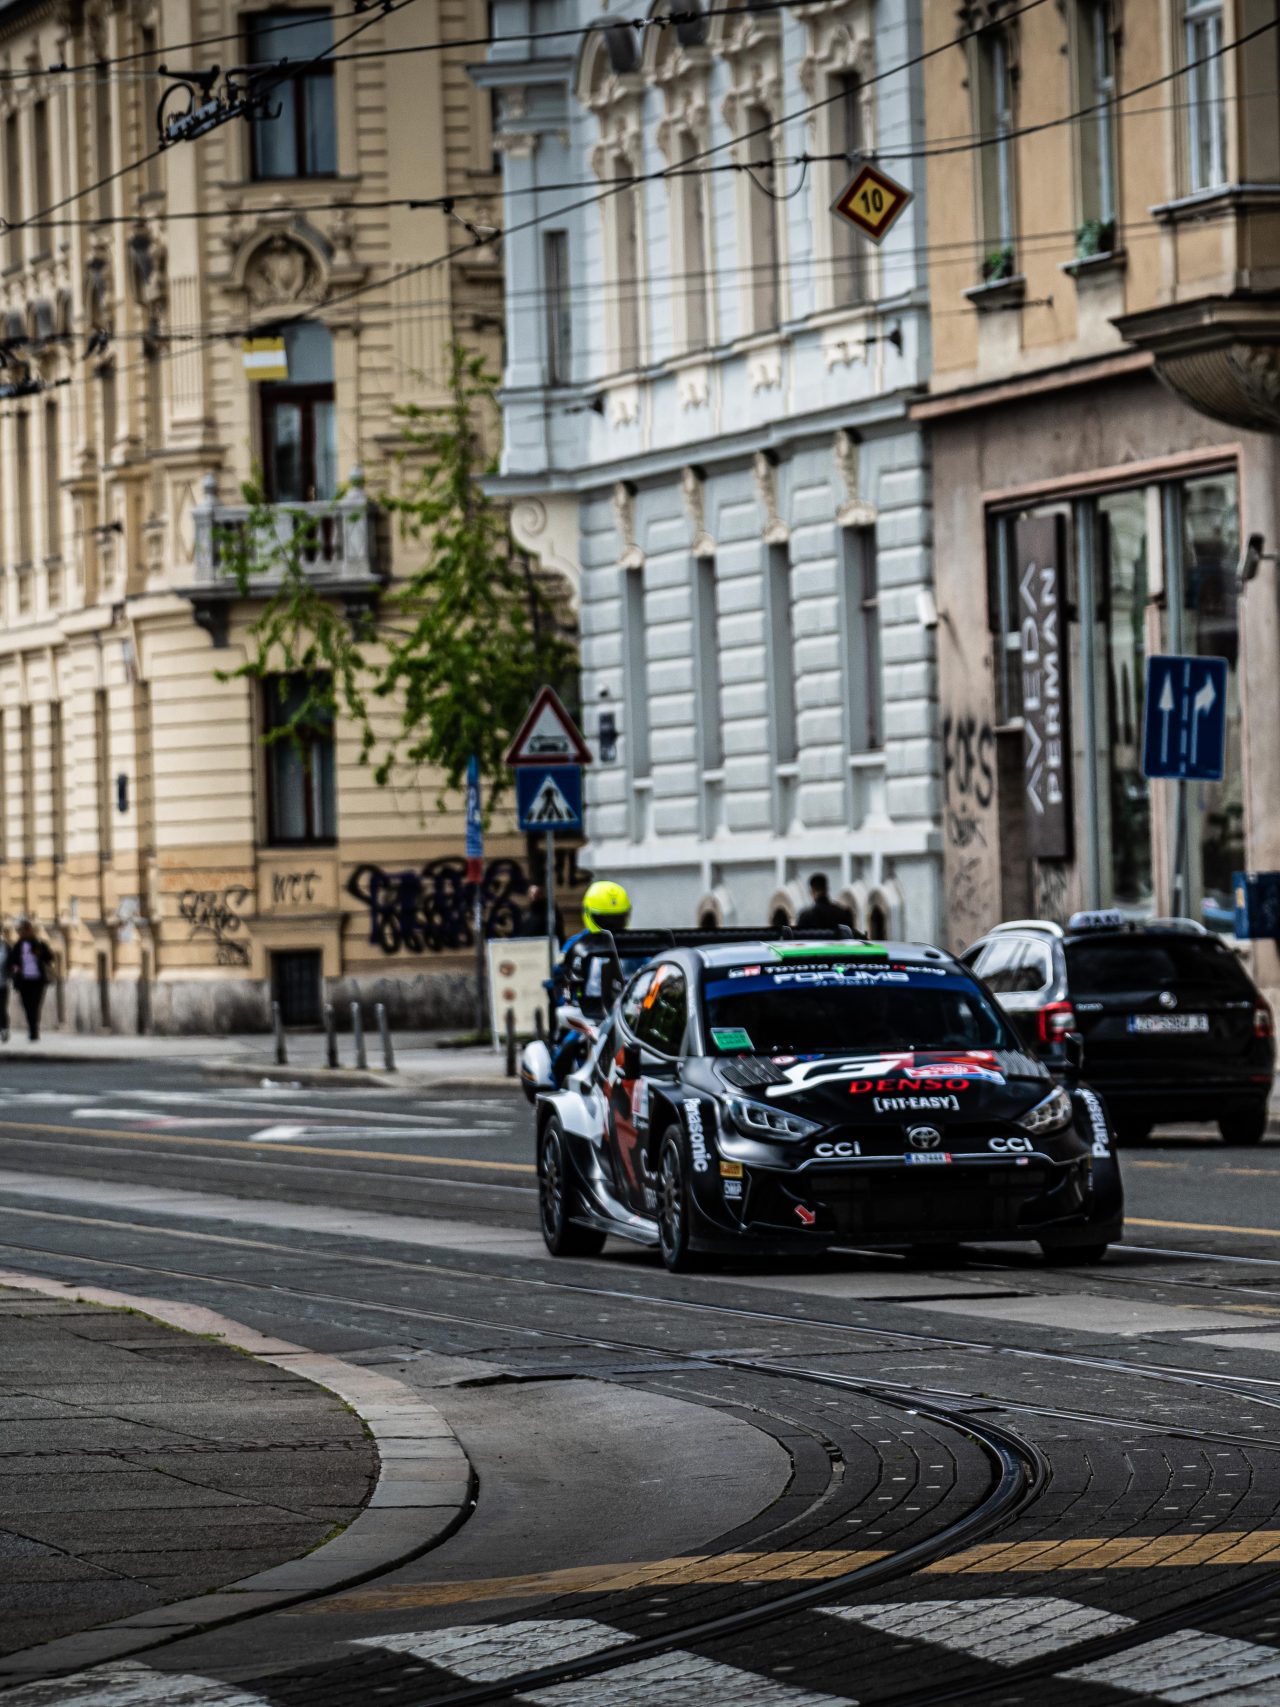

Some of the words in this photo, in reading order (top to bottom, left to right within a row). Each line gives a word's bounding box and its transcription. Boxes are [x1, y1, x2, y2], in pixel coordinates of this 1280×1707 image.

[861, 188, 884, 215] 10
[1019, 561, 1045, 814] AVEDA
[849, 1079, 970, 1094] DENSO
